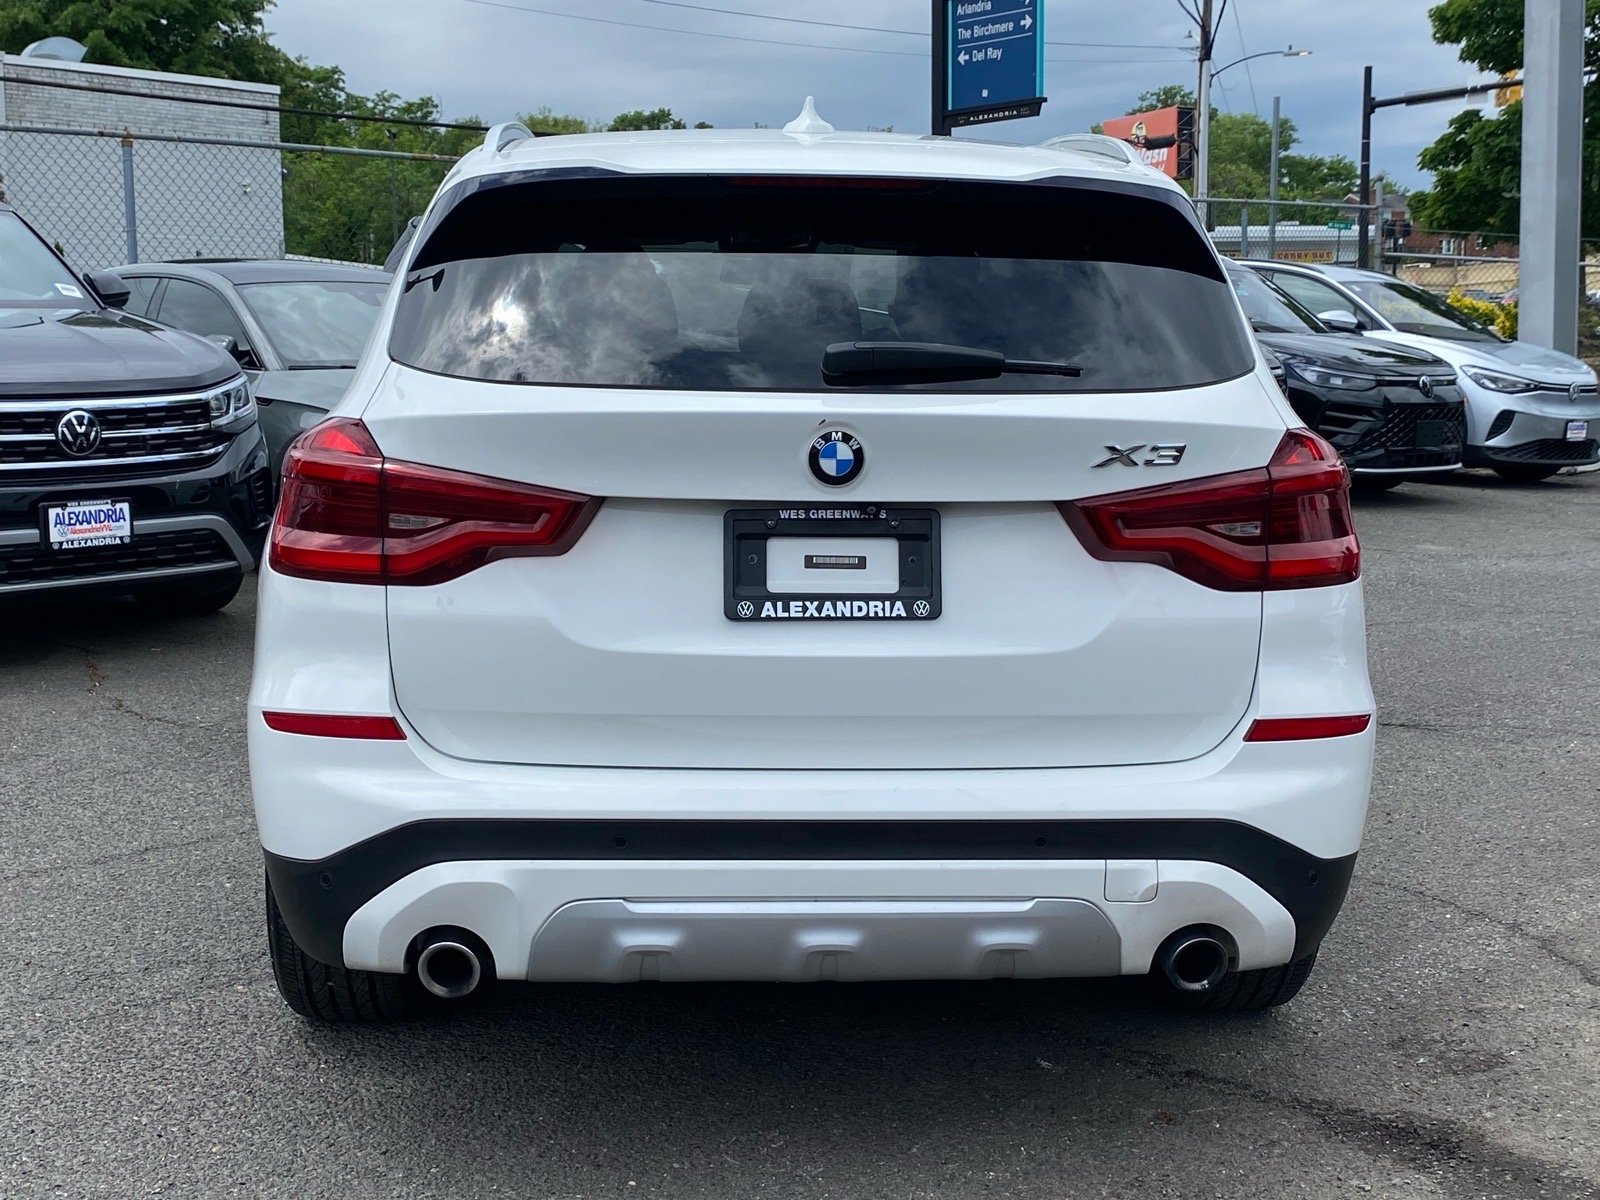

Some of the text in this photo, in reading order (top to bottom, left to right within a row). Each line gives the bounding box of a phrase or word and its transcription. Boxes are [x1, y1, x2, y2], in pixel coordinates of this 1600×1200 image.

[957, 0, 992, 16] Arlandria
[957, 21, 1014, 40] The Birchmere
[972, 47, 1003, 62] Del Ray
[969, 110, 1018, 121] ALEXANDRIA
[813, 431, 861, 450] BMW
[1090, 443, 1187, 468] X3
[54, 507, 127, 528] ALEXANDRIA
[779, 510, 887, 519] WES GREENWS
[61, 537, 122, 549] ALEXANDRIA
[760, 601, 907, 618] ALEXANDRIA
